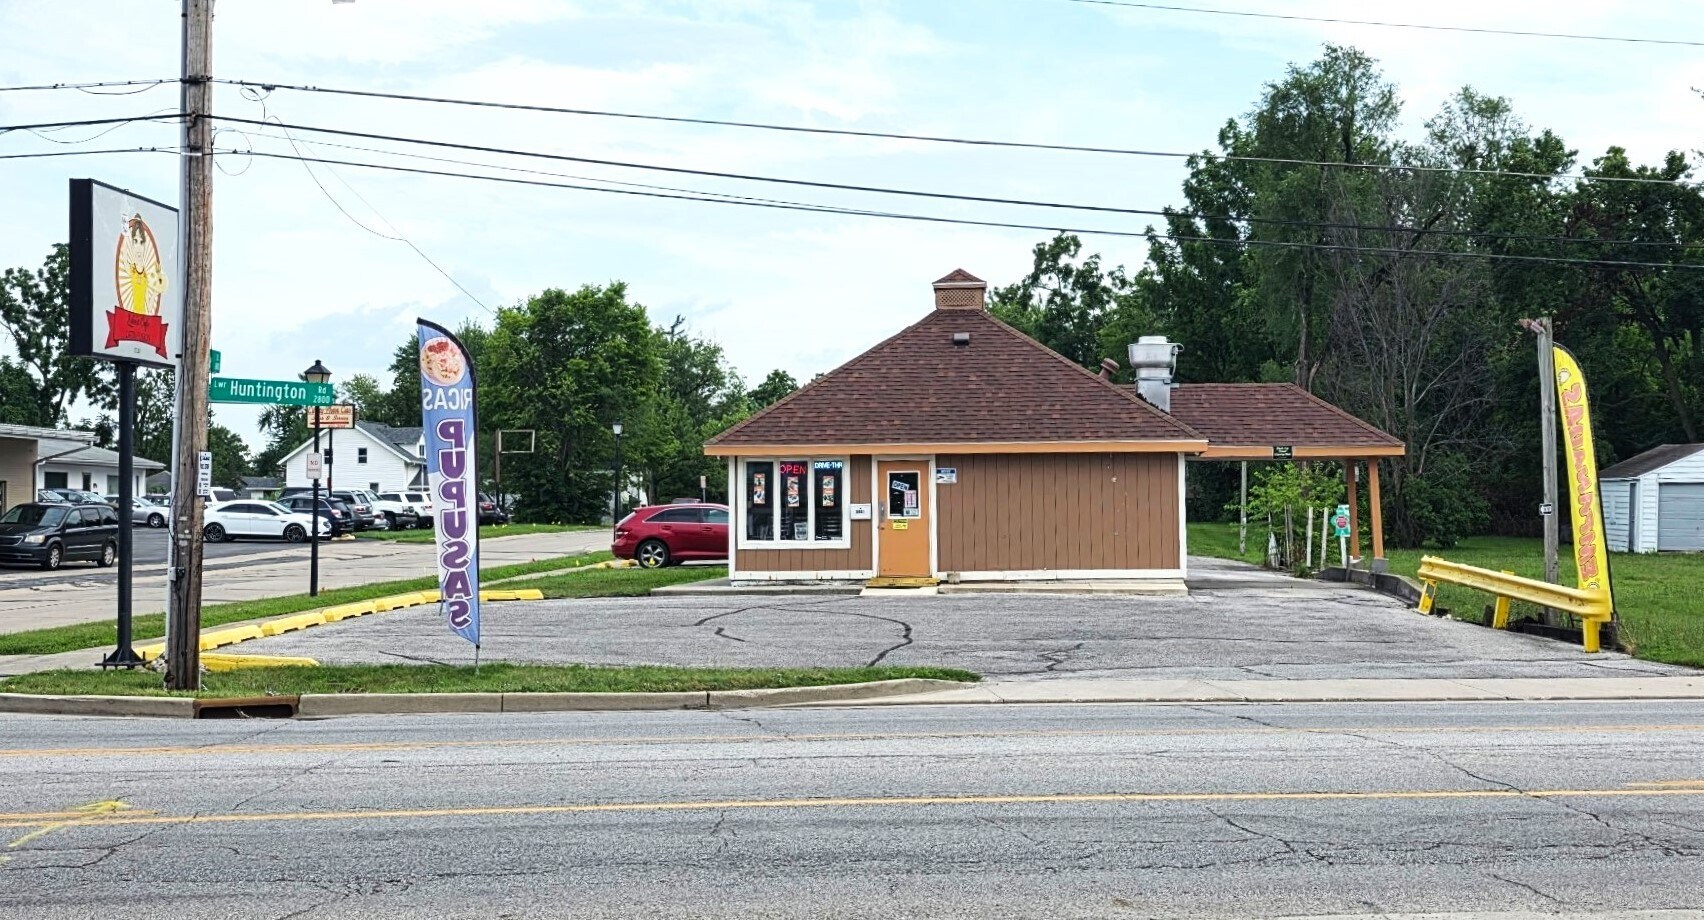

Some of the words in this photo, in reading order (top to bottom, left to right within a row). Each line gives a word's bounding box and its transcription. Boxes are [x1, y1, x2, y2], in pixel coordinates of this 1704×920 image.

[214, 380, 227, 389] Lwr
[230, 380, 306, 402] Huntington
[318, 386, 327, 394] Rd
[313, 395, 331, 404] 2800
[779, 464, 806, 475] OPEN
[893, 481, 909, 491] OPEN
